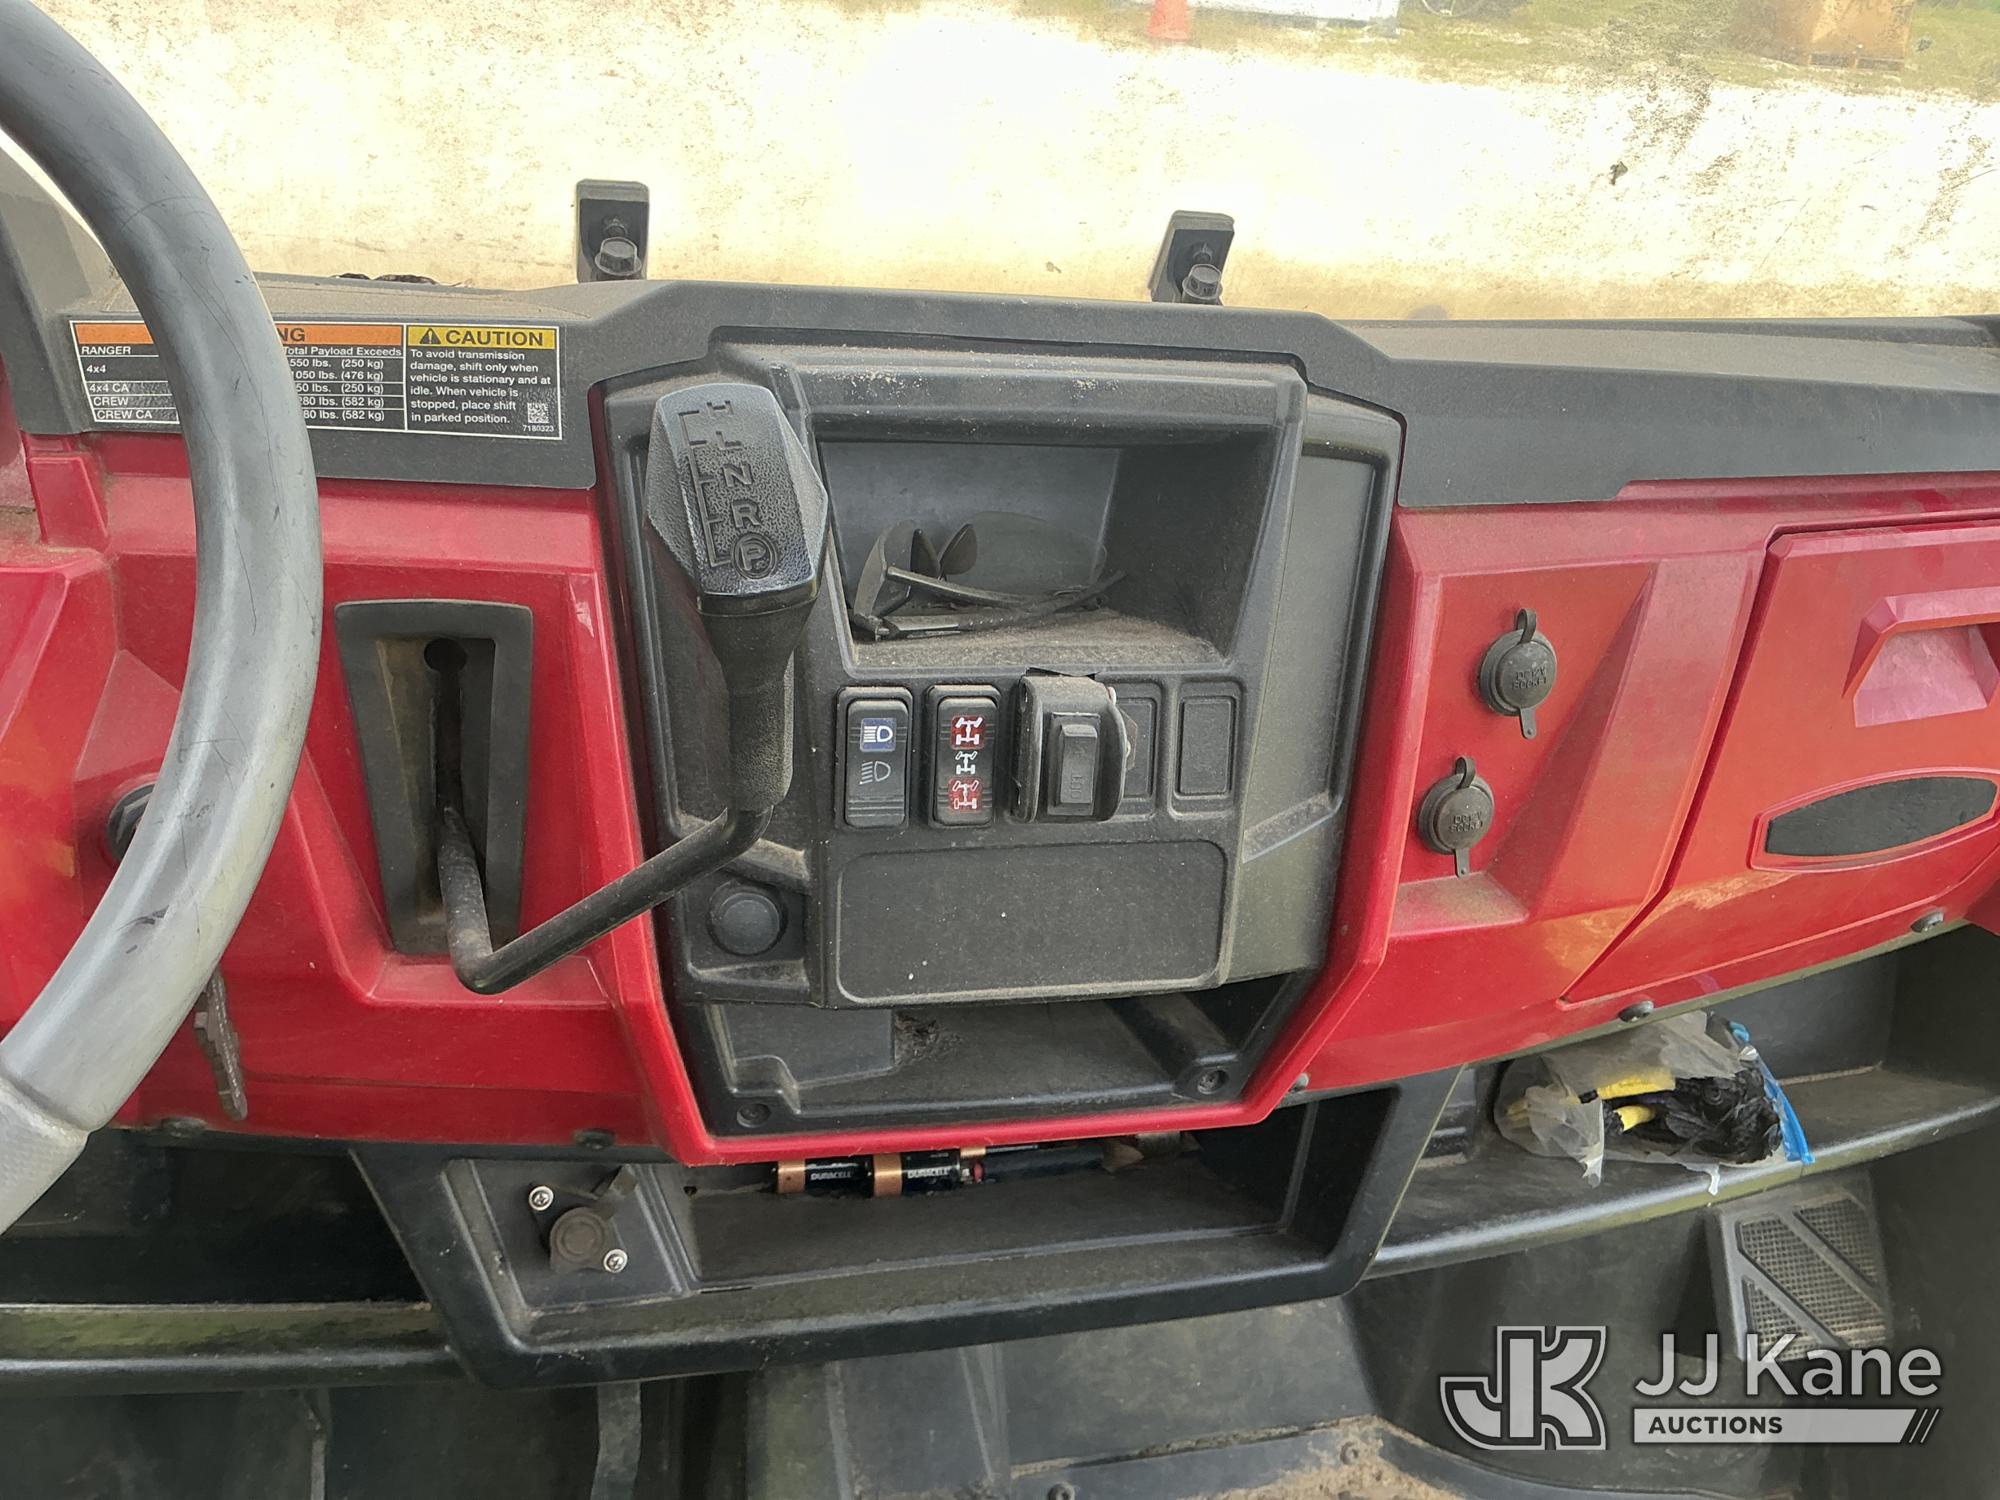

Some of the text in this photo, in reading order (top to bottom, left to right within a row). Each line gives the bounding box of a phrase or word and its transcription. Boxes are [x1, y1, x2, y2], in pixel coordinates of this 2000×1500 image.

[445, 330, 543, 346] CAUTION
[81, 346, 131, 355] RANGER
[311, 347, 353, 356] Payload
[356, 347, 402, 356] Exceeds
[410, 349, 525, 360] To avoid transmission
[86, 364, 106, 373] 4x4
[290, 359, 384, 369] 550 lbs. (250 kg)
[410, 361, 538, 373] damage, shift only when
[319, 371, 337, 379] lbs.
[341, 371, 364, 381] (476
[367, 371, 383, 381] kg)
[410, 373, 551, 386] vehicle is stationary and at
[89, 384, 129, 393] 4x4 CA
[312, 383, 331, 392] lbs.
[341, 384, 364, 393] (250
[367, 384, 384, 394] kg)
[410, 386, 518, 397] idle. When vehicle is
[93, 397, 128, 406] CREW
[319, 397, 338, 406] lbs.
[341, 397, 365, 407] (582
[368, 398, 384, 408] kg)
[410, 399, 516, 411] stopped, place shift
[97, 410, 152, 419] CREW CA
[706, 400, 733, 418] H
[320, 410, 339, 419] lbs.
[342, 410, 365, 421] (582
[368, 411, 385, 421] kg)
[411, 412, 510, 424] in parked position.
[716, 430, 743, 450] L
[721, 463, 752, 488] N
[732, 499, 760, 528] R
[739, 539, 766, 571] P
[907, 1166, 951, 1179] DURACELL
